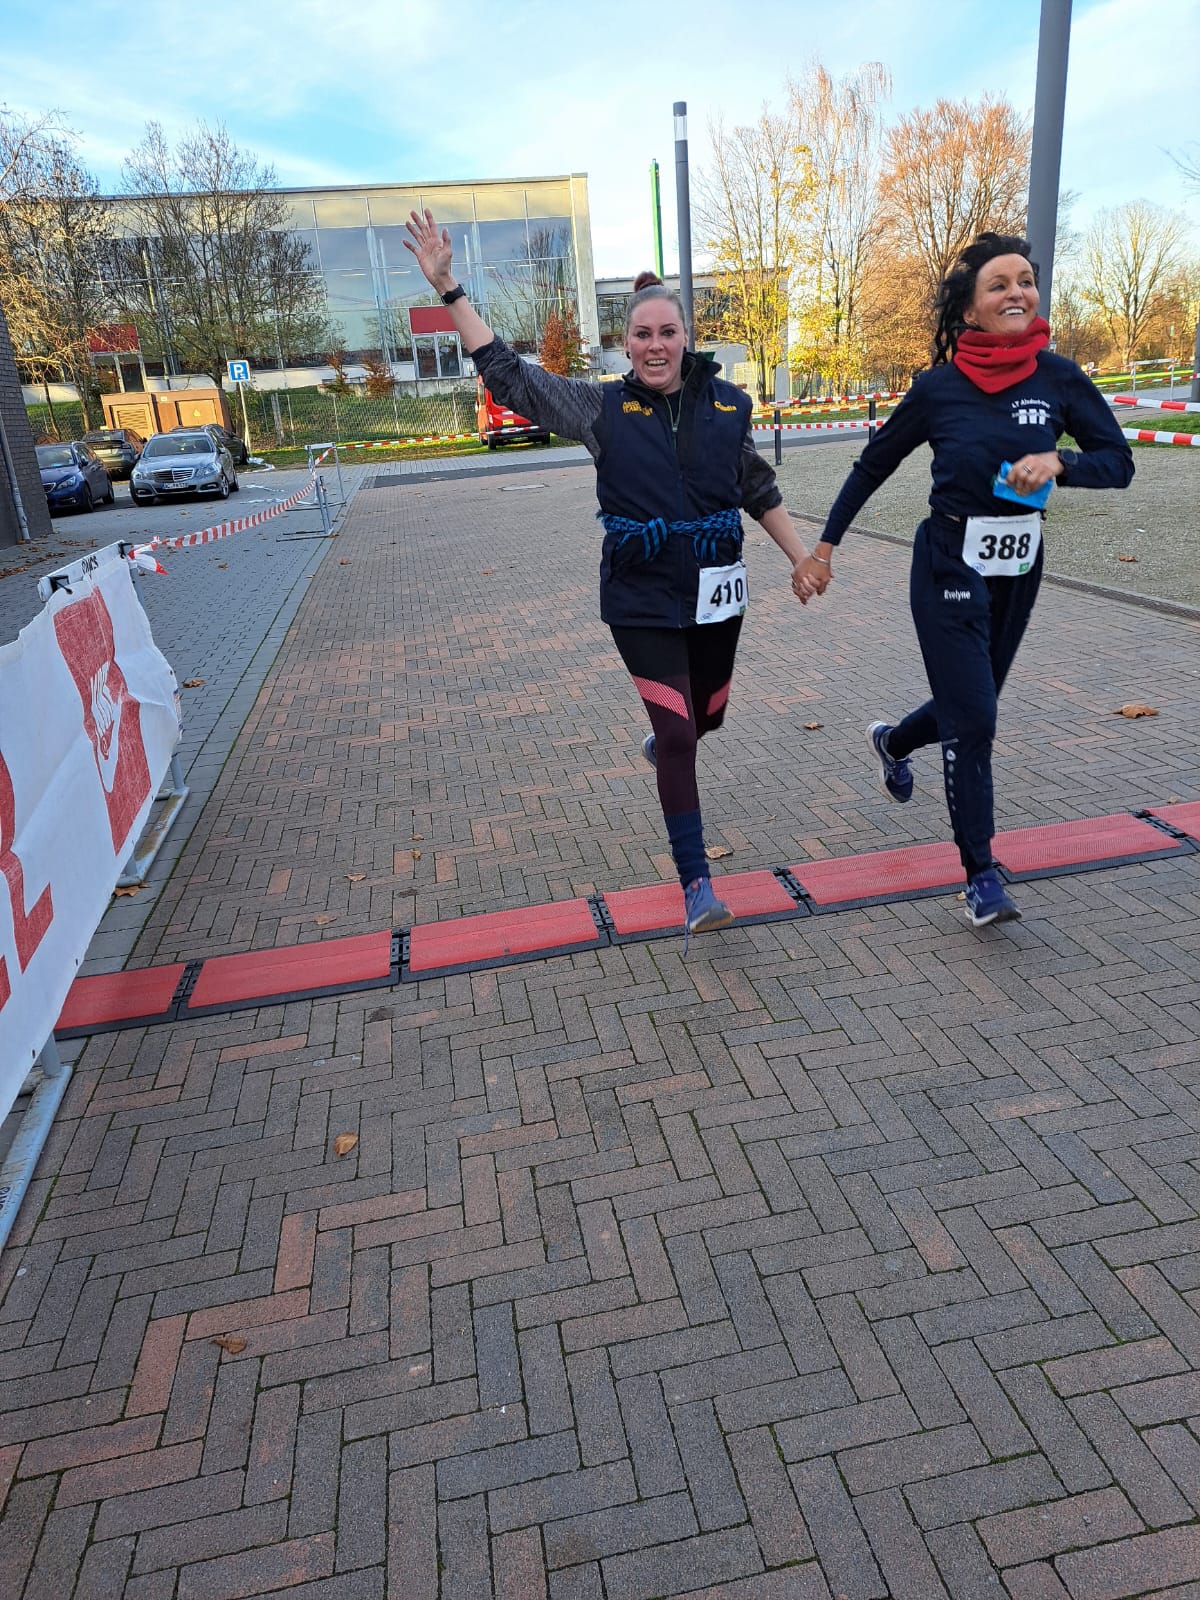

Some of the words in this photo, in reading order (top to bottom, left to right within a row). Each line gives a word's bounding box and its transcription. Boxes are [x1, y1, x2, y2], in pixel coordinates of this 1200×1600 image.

[233, 364, 244, 379] P
[978, 532, 1031, 560] 388
[710, 577, 743, 607] 410
[944, 588, 971, 602] Evelyne
